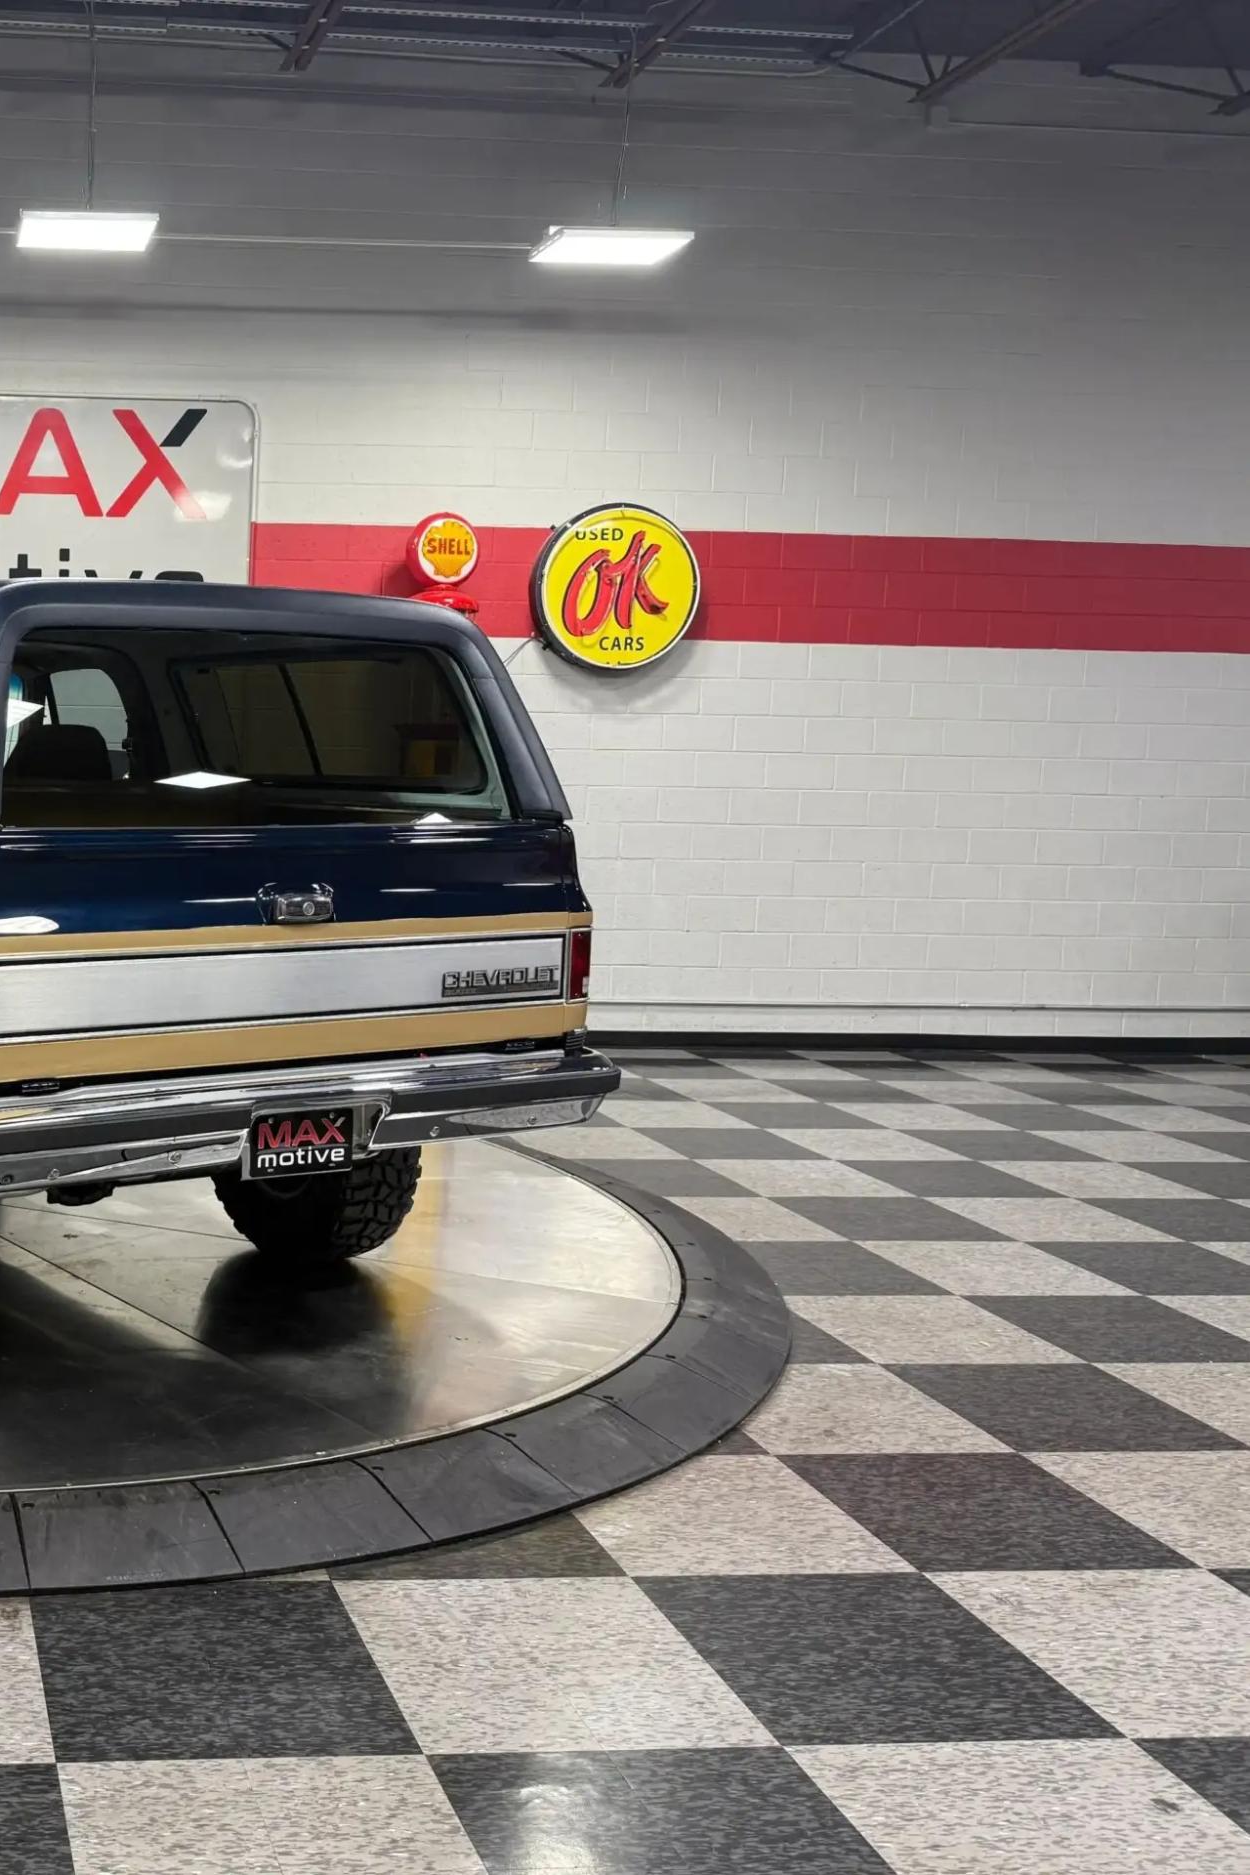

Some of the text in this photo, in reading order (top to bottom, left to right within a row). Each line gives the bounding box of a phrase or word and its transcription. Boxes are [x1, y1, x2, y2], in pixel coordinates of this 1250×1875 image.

[575, 528, 624, 541] USED
[426, 537, 471, 556] SHELL
[561, 531, 669, 637] OK
[599, 636, 645, 651] CARS
[443, 965, 559, 989] CHEVROLET
[258, 1117, 346, 1149] MAX
[257, 1146, 345, 1168] motive
